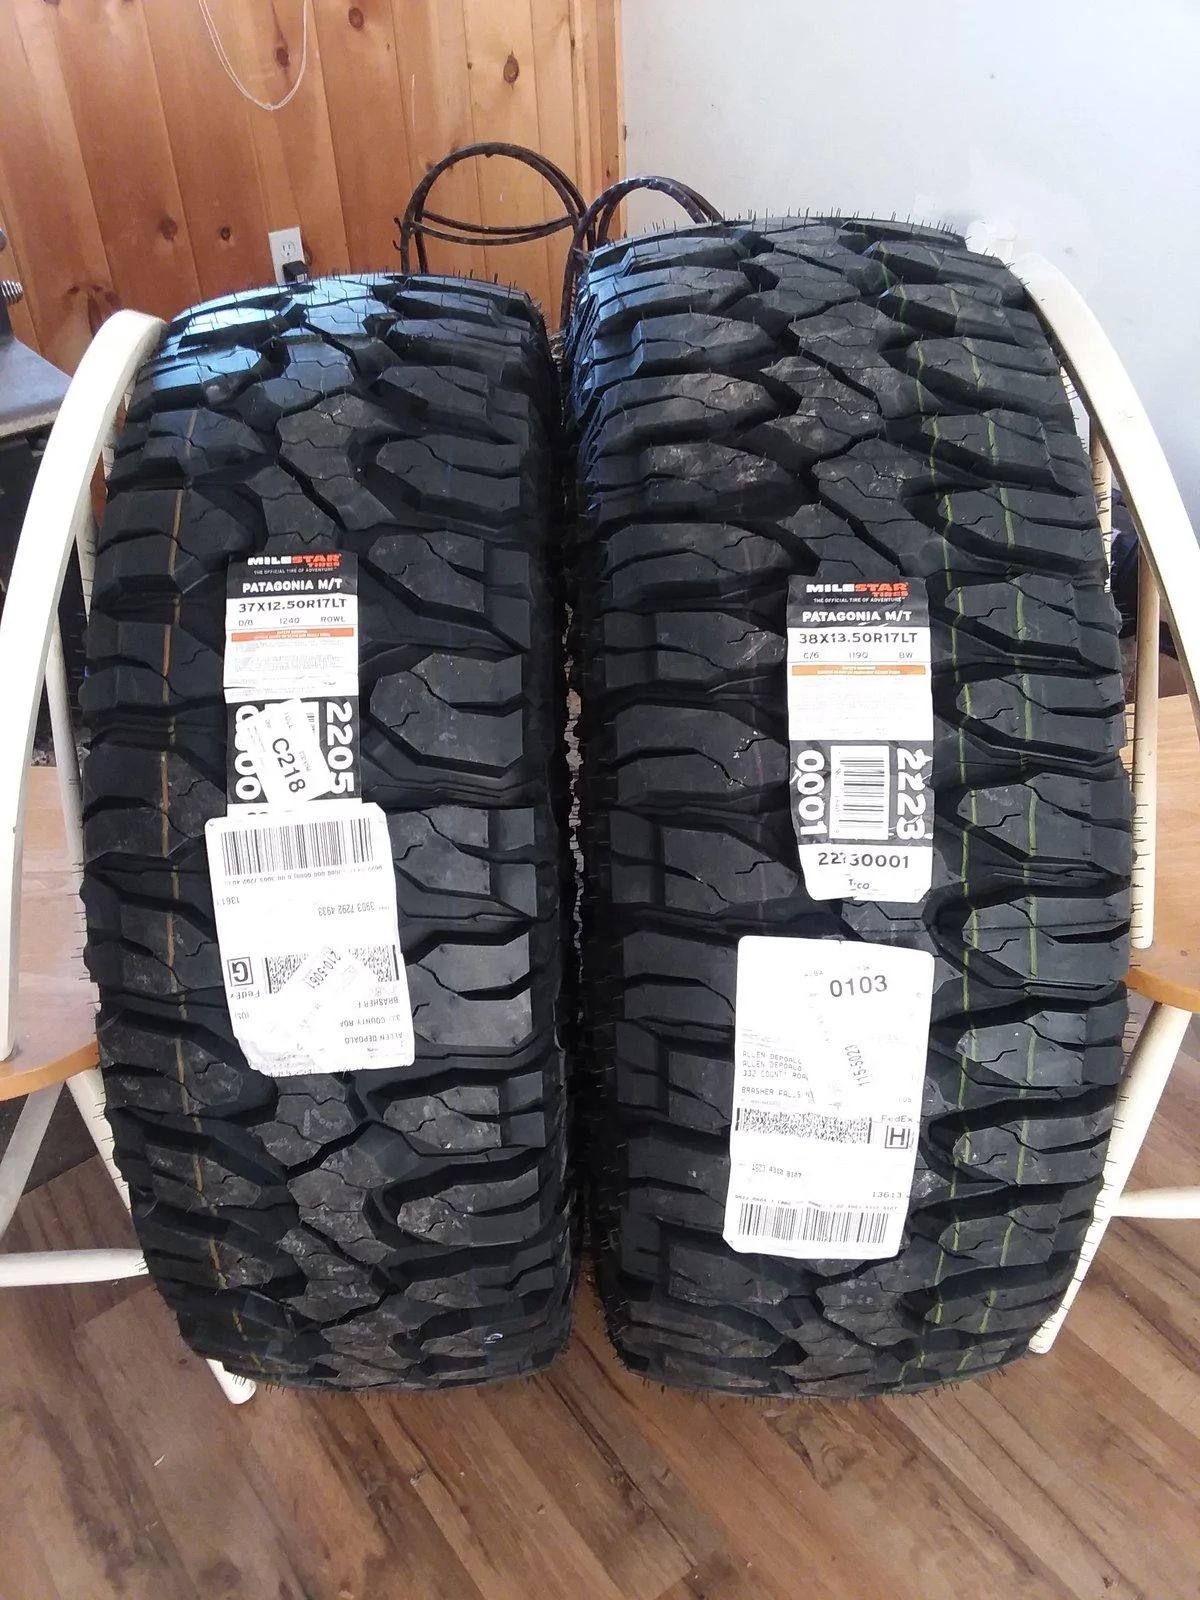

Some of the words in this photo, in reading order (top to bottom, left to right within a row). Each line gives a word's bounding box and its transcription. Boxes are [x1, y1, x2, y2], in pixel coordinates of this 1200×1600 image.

[242, 580, 314, 593] PATAGONIA
[317, 577, 343, 591] M/T
[238, 598, 347, 613] 37X12.50R17LT
[802, 611, 881, 623] PATAGONIA
[885, 610, 912, 622] M/T
[799, 632, 918, 644] 38X13.50R17LT
[272, 738, 306, 793] C218
[896, 748, 927, 839] 2223
[231, 960, 250, 983] G
[829, 975, 888, 998] 0103
[889, 1127, 906, 1145] H
